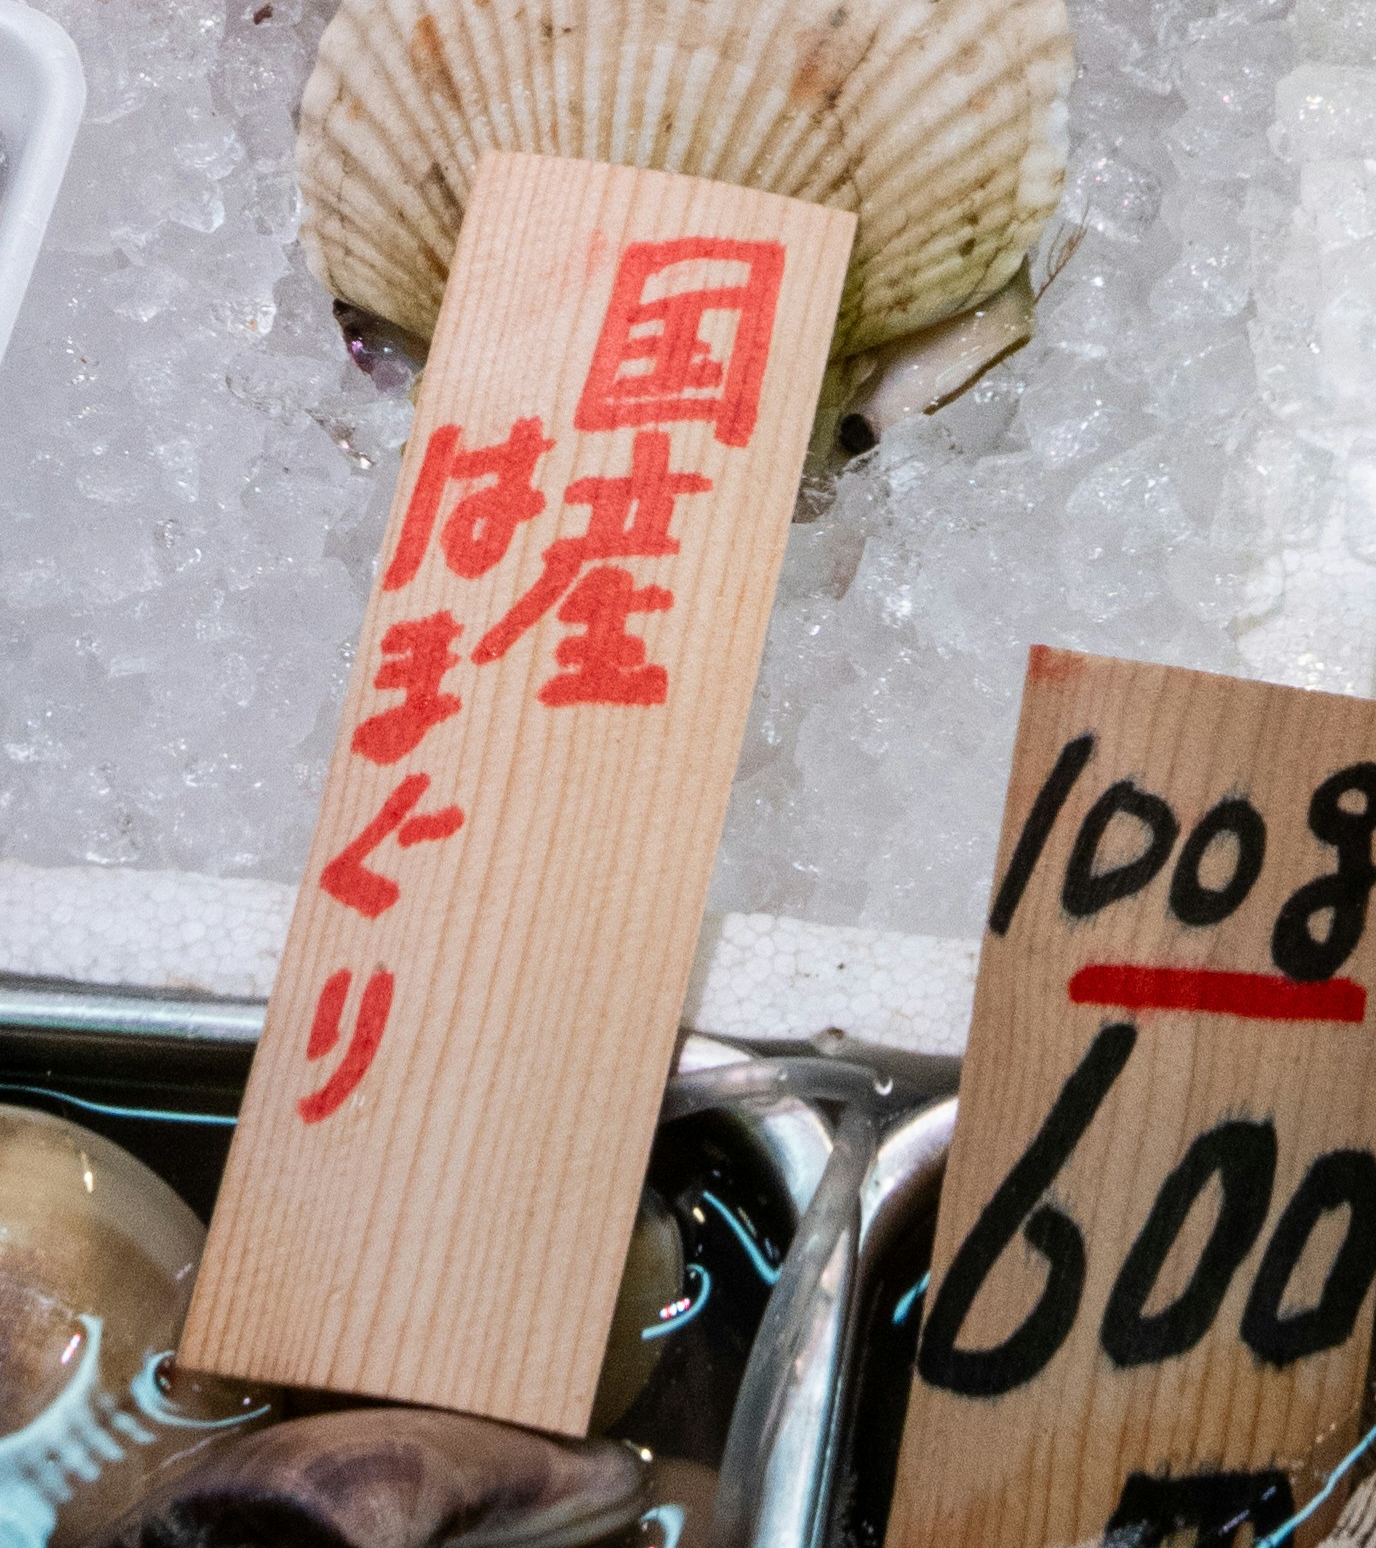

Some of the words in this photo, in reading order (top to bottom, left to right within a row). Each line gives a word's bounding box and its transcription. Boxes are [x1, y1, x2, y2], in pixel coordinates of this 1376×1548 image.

[473, 236, 787, 707] 国産
[298, 415, 556, 1125] はまぐり
